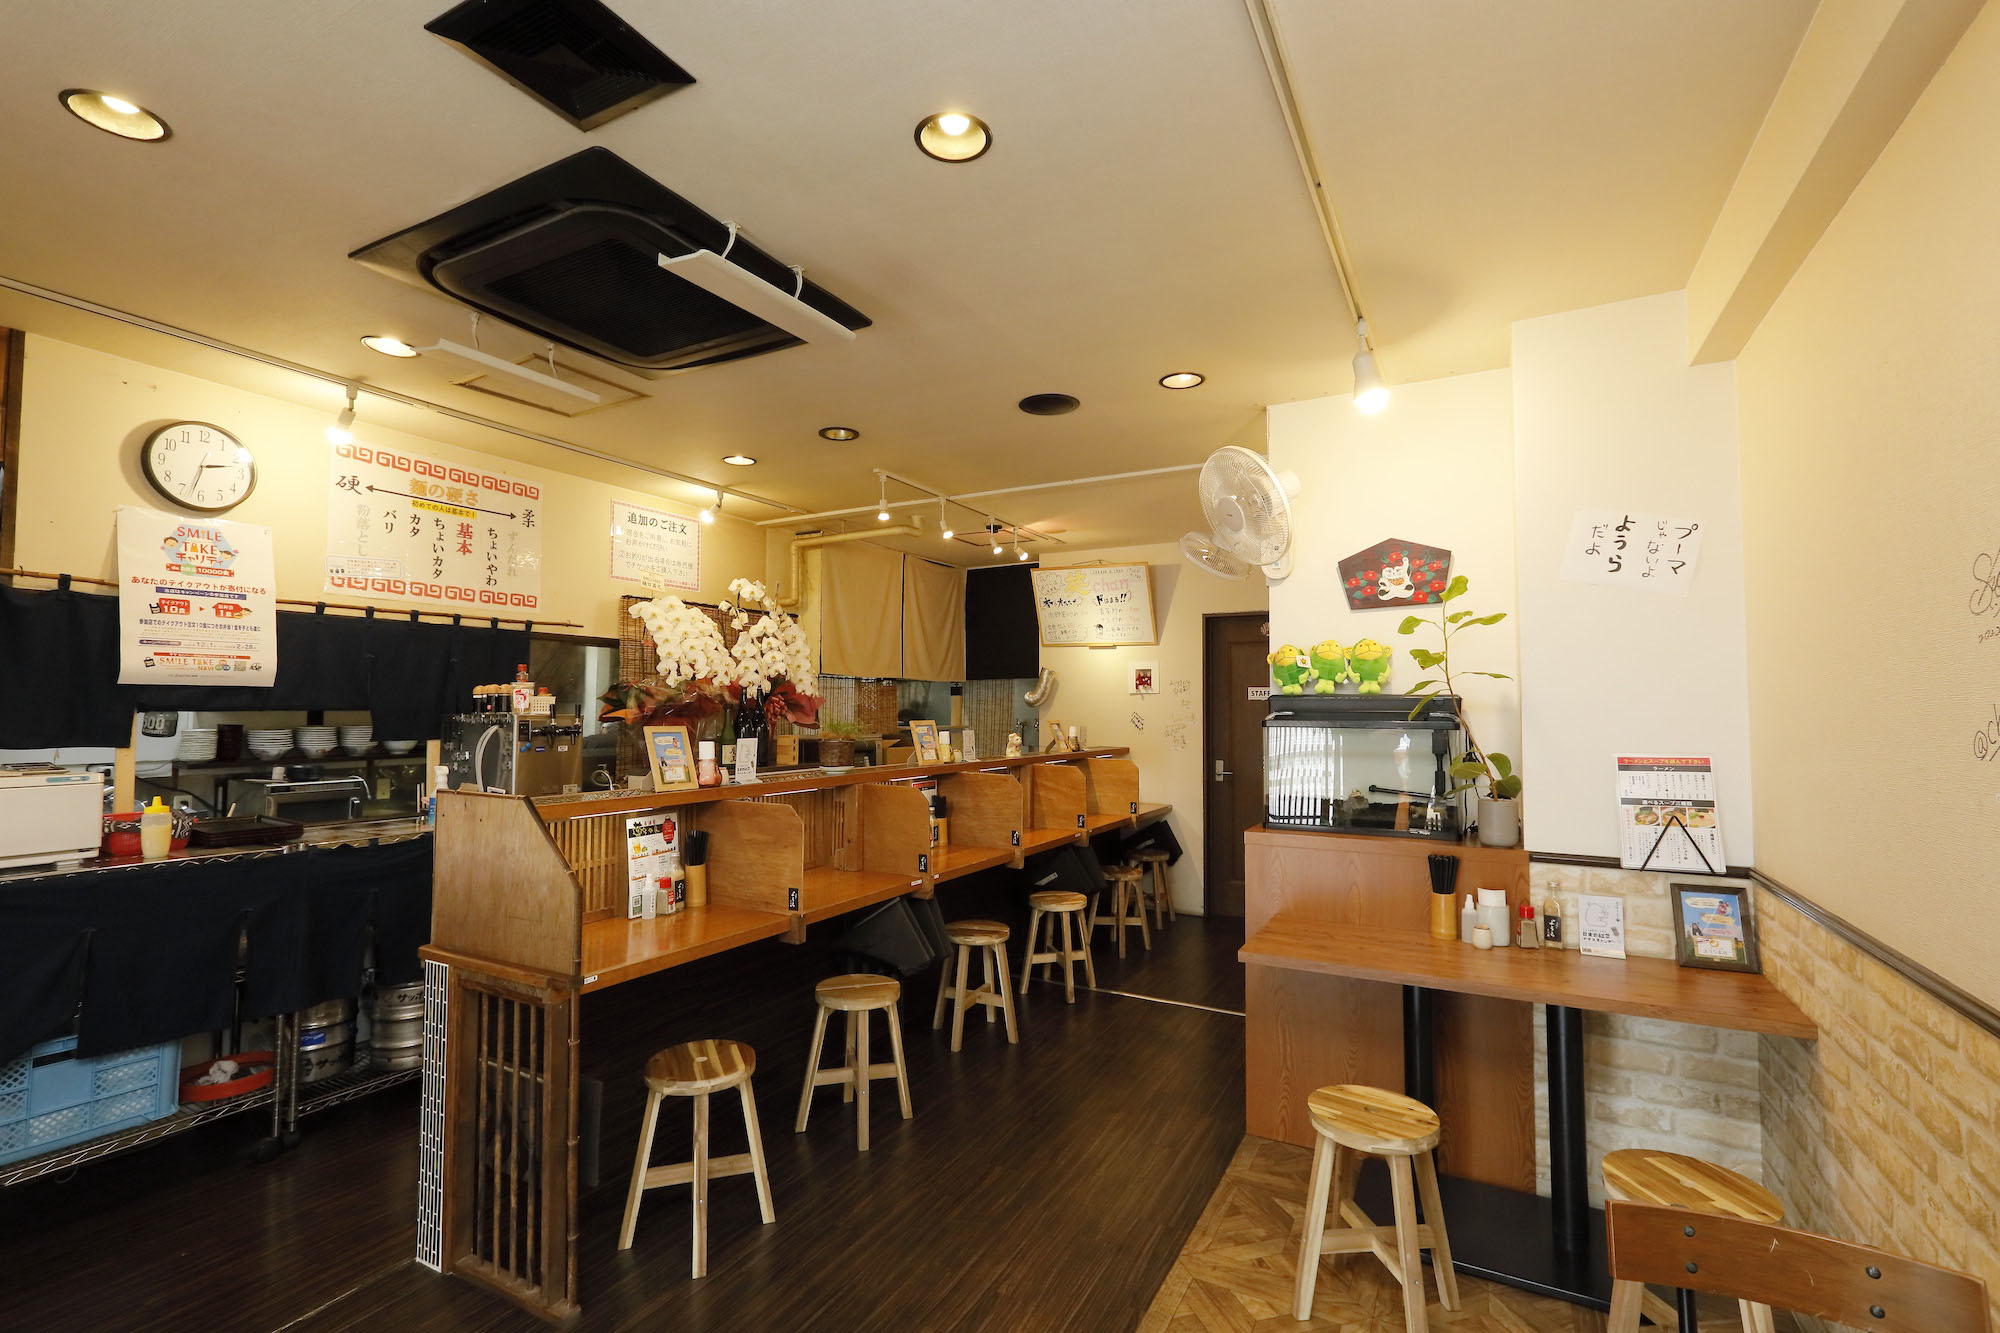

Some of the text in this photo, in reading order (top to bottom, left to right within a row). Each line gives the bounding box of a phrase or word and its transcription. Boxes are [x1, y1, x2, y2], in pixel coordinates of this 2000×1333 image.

[164, 438, 176, 451] 10
[180, 430, 190, 443] 11
[200, 430, 210, 443] 12
[158, 453, 165, 465] 9
[164, 470, 172, 482] 8
[238, 468, 245, 480] 3
[179, 483, 186, 495] 7
[230, 482, 236, 495] 4
[335, 475, 362, 495] 硬
[409, 478, 479, 506] 麺の硬さ
[197, 490, 205, 502] 6
[217, 489, 223, 501] 5
[384, 509, 397, 534] バリ
[409, 514, 421, 537] カタ
[522, 509, 535, 528] 柔
[627, 511, 687, 535] 追加のご注文
[457, 522, 473, 555] 基本
[1585, 524, 1608, 555] だよ
[1608, 515, 1636, 573] ようら
[432, 518, 446, 579] ちょいカタ
[486, 527, 498, 586] ちょいやわ
[1641, 520, 1667, 578] じゃないよ
[1668, 523, 1699, 575] プーマ
[176, 552, 224, 566] チャリティ
[131, 576, 266, 595] あなたのテイクアウトが寄付になる
